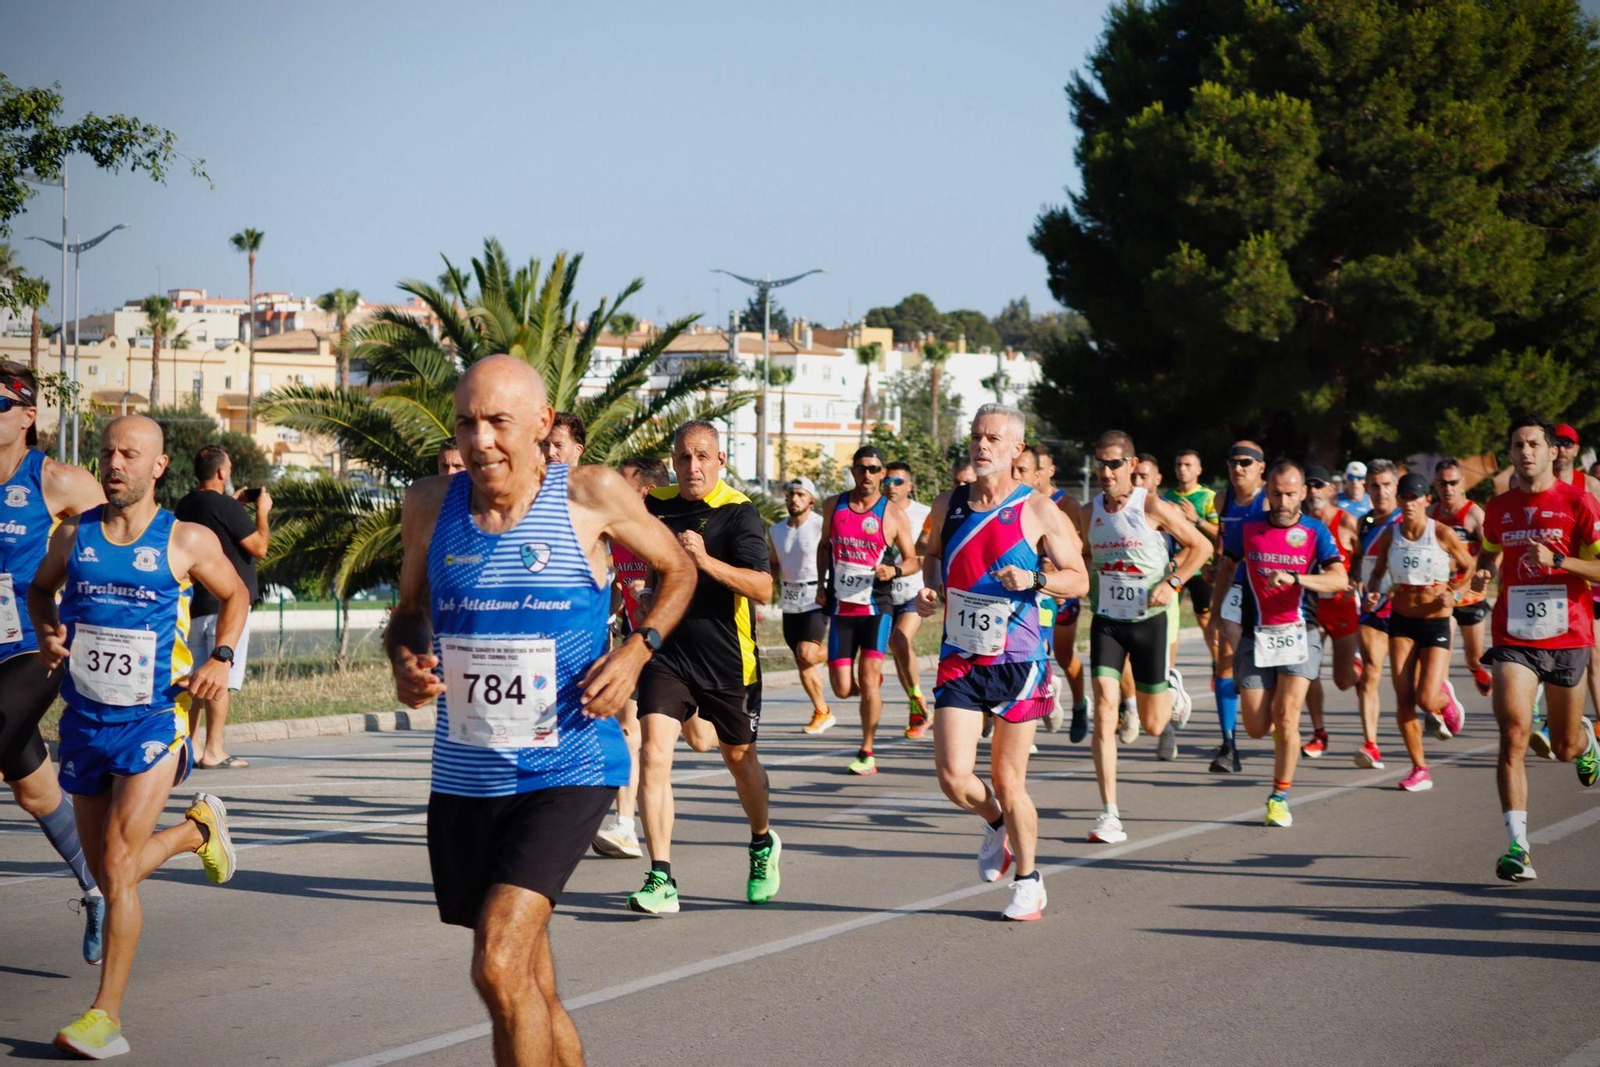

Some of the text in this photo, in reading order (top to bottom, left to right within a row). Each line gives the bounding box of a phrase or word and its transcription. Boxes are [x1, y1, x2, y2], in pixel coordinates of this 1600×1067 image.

[1249, 550, 1308, 565] GADEIRAS
[1403, 556, 1420, 568] 96
[839, 574, 863, 588] 497
[76, 580, 157, 601] Tirabuzón
[1109, 586, 1135, 601] 120
[456, 596, 518, 614] Atletismo
[521, 594, 572, 611] Linense
[1230, 594, 1242, 608] 3
[1525, 602, 1547, 618] 93
[958, 609, 991, 632] 113
[1266, 635, 1295, 650] 356
[87, 649, 132, 676] 373
[463, 673, 526, 705] 784
